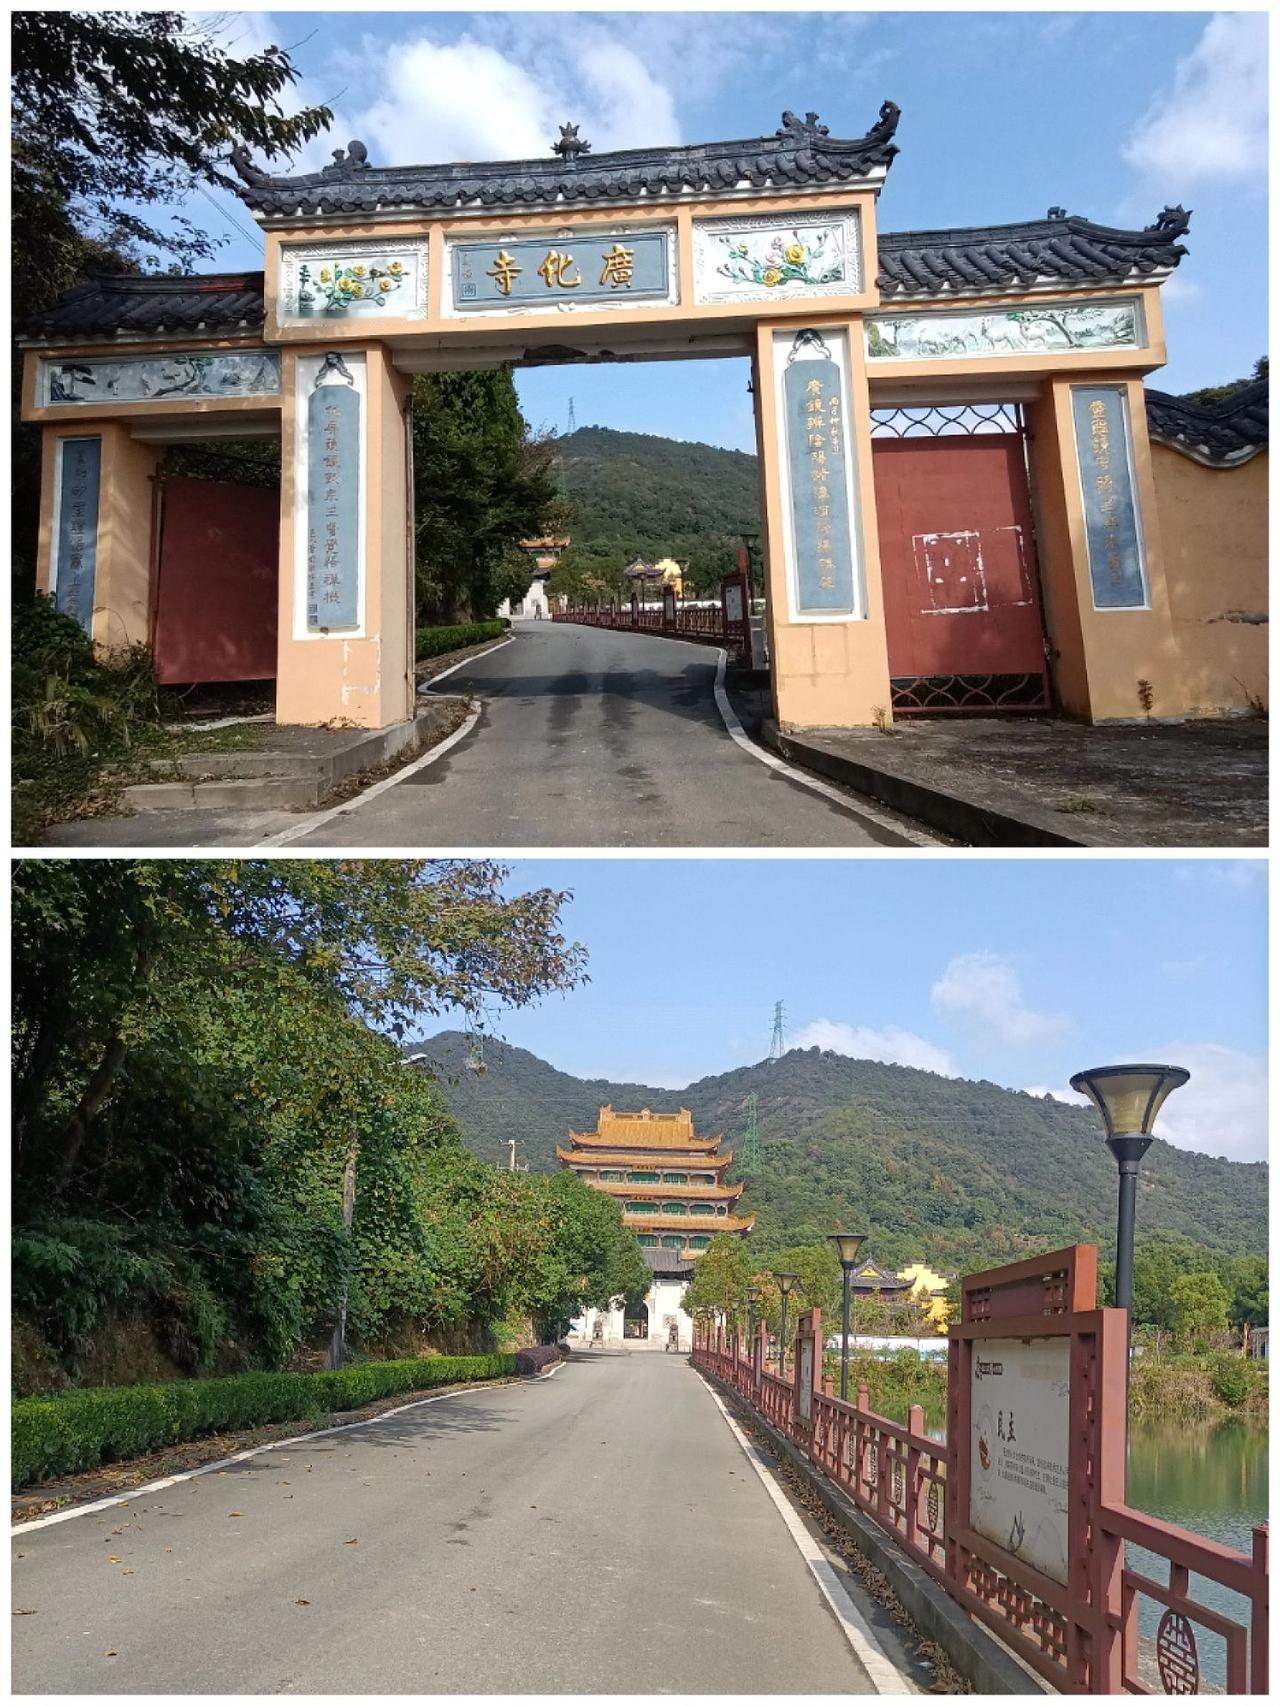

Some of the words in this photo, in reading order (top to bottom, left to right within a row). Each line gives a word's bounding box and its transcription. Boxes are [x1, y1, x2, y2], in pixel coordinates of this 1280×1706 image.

[486, 243, 635, 295] 廣化寺
[997, 1409, 1017, 1442] 民主
